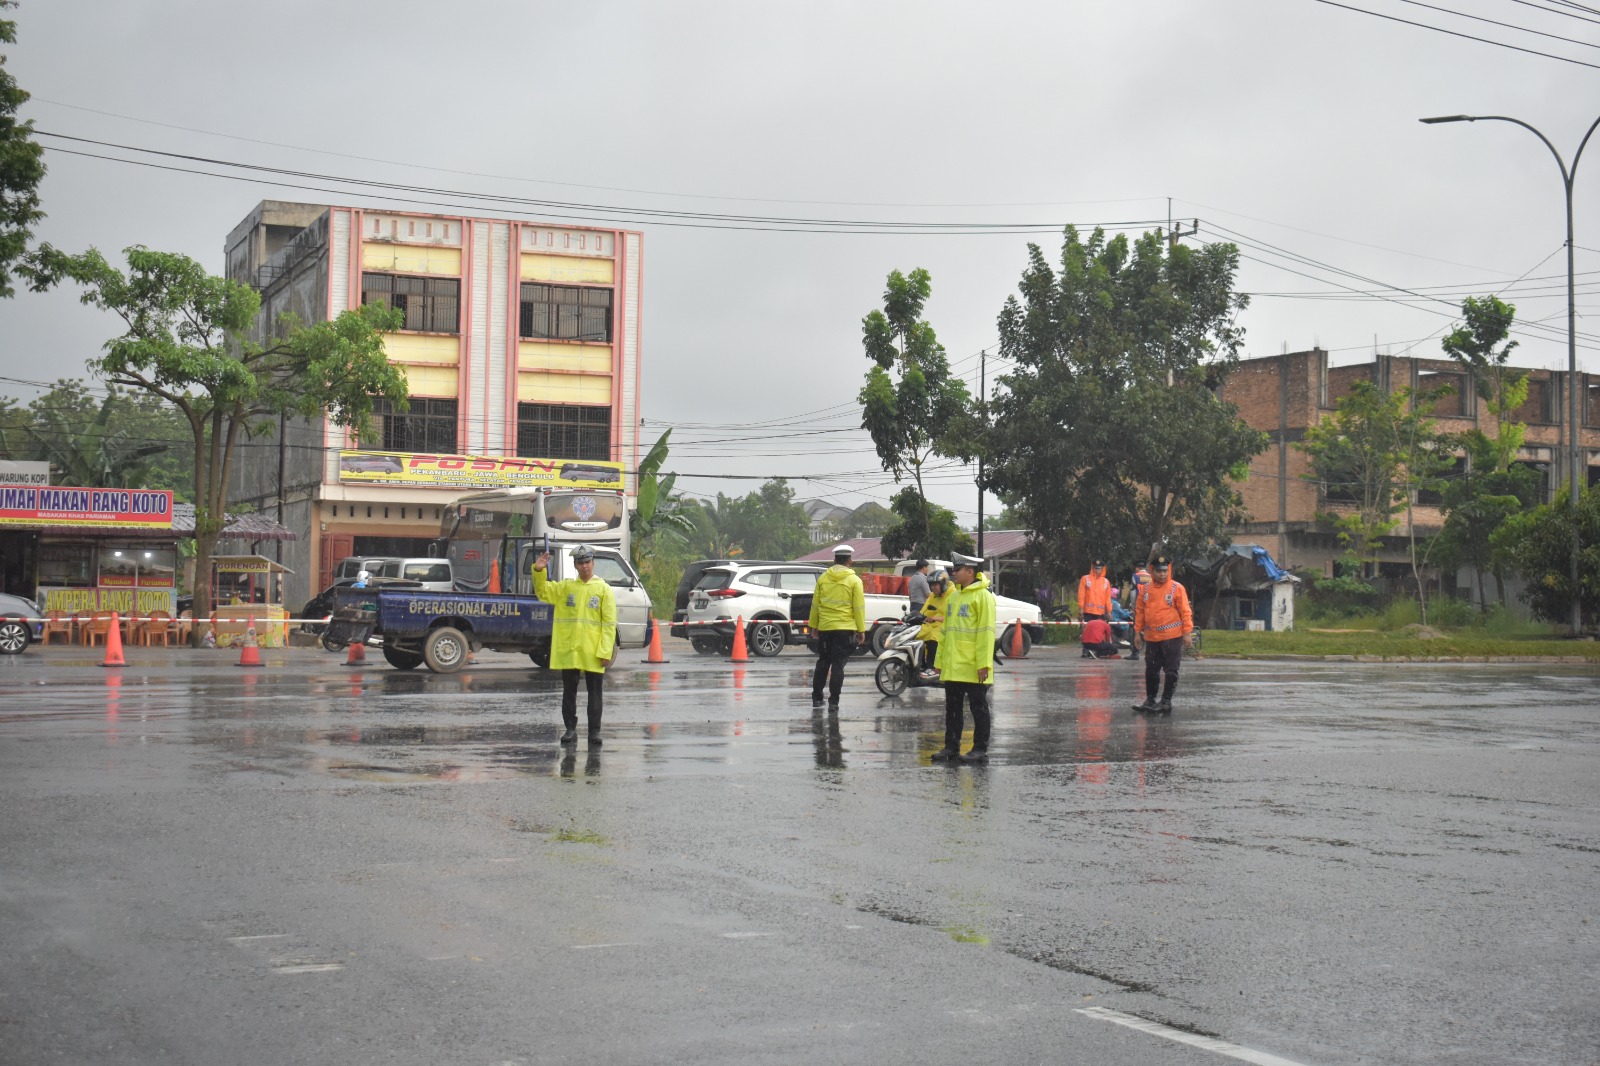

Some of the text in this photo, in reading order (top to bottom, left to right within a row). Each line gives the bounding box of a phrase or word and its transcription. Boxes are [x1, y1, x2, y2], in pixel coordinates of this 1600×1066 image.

[408, 455, 556, 473] PO SAN
[0, 473, 48, 484] WARUNG KOPI
[410, 468, 466, 477] PEKANBARU
[473, 470, 499, 479] JAWA
[506, 472, 554, 480] BENGKULU
[39, 489, 90, 512] MAKAN
[92, 490, 130, 513] RANG
[132, 492, 168, 515] KOTO
[217, 562, 268, 570] GORENGAN
[104, 577, 132, 586] Masakan
[140, 578, 171, 587] Pariaman
[45, 588, 171, 615] AMPERA RANG KOTO
[409, 601, 487, 615] OPERASIONAL
[489, 603, 521, 616] APILL
